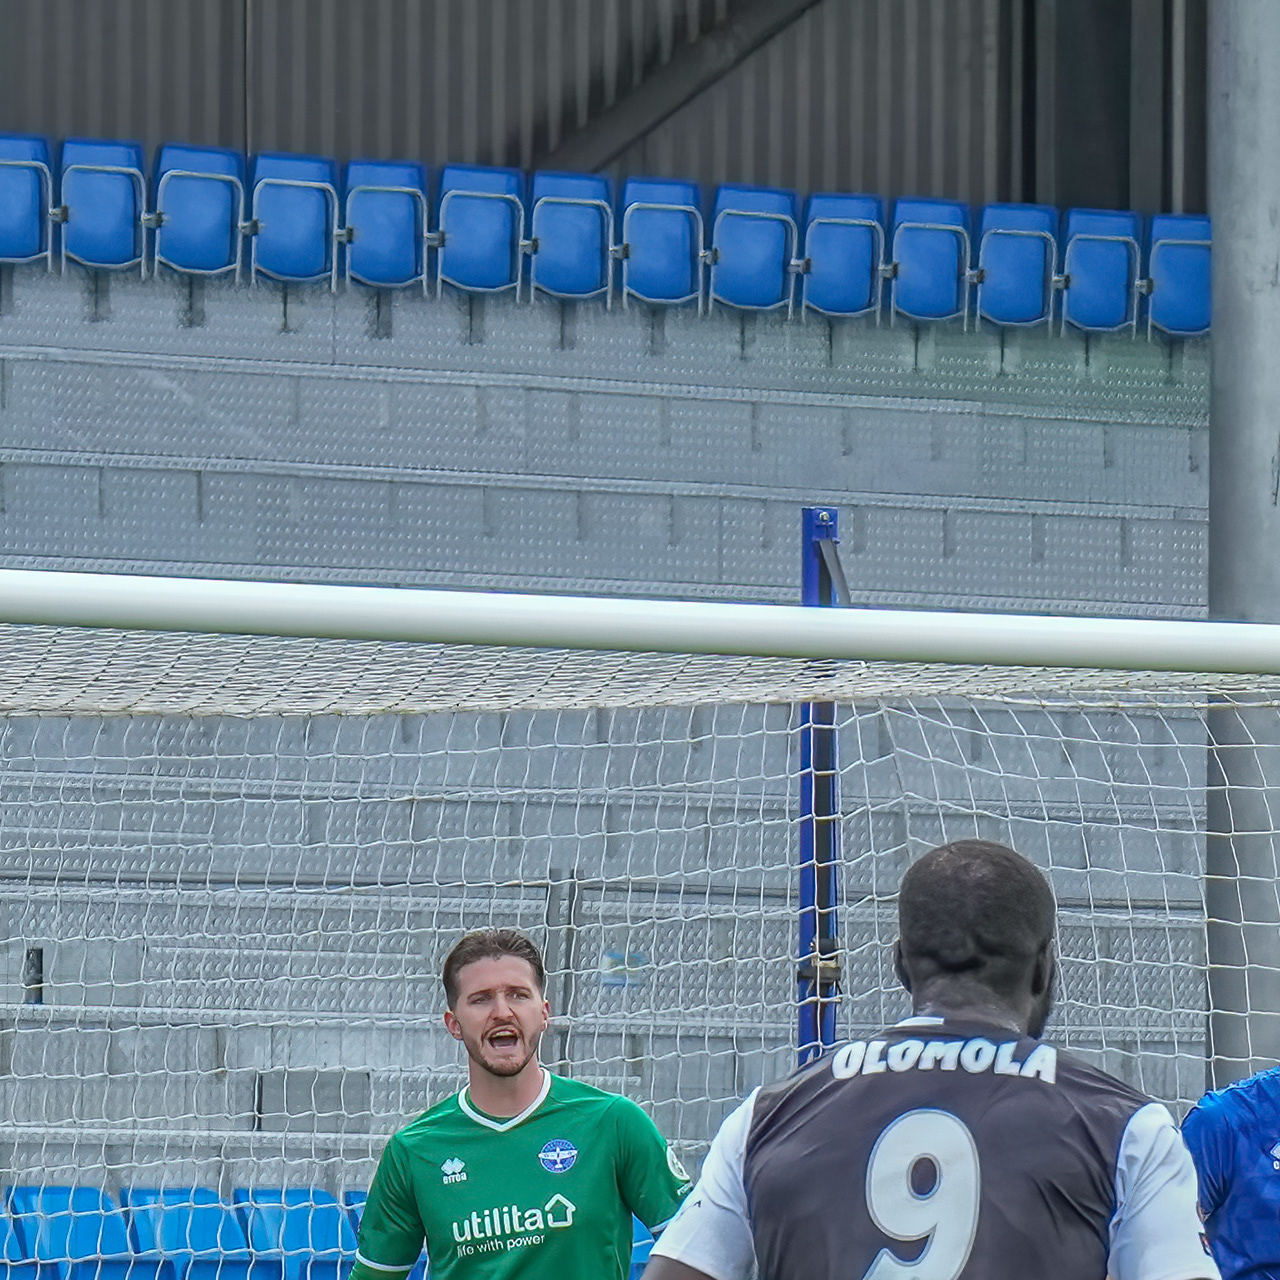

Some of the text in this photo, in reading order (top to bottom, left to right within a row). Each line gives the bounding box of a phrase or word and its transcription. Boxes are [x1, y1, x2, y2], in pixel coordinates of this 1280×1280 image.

[831, 1037, 1056, 1084] OLOMOLA
[453, 1205, 545, 1242] utilita
[477, 1239, 503, 1253] with
[507, 1234, 545, 1251] power
